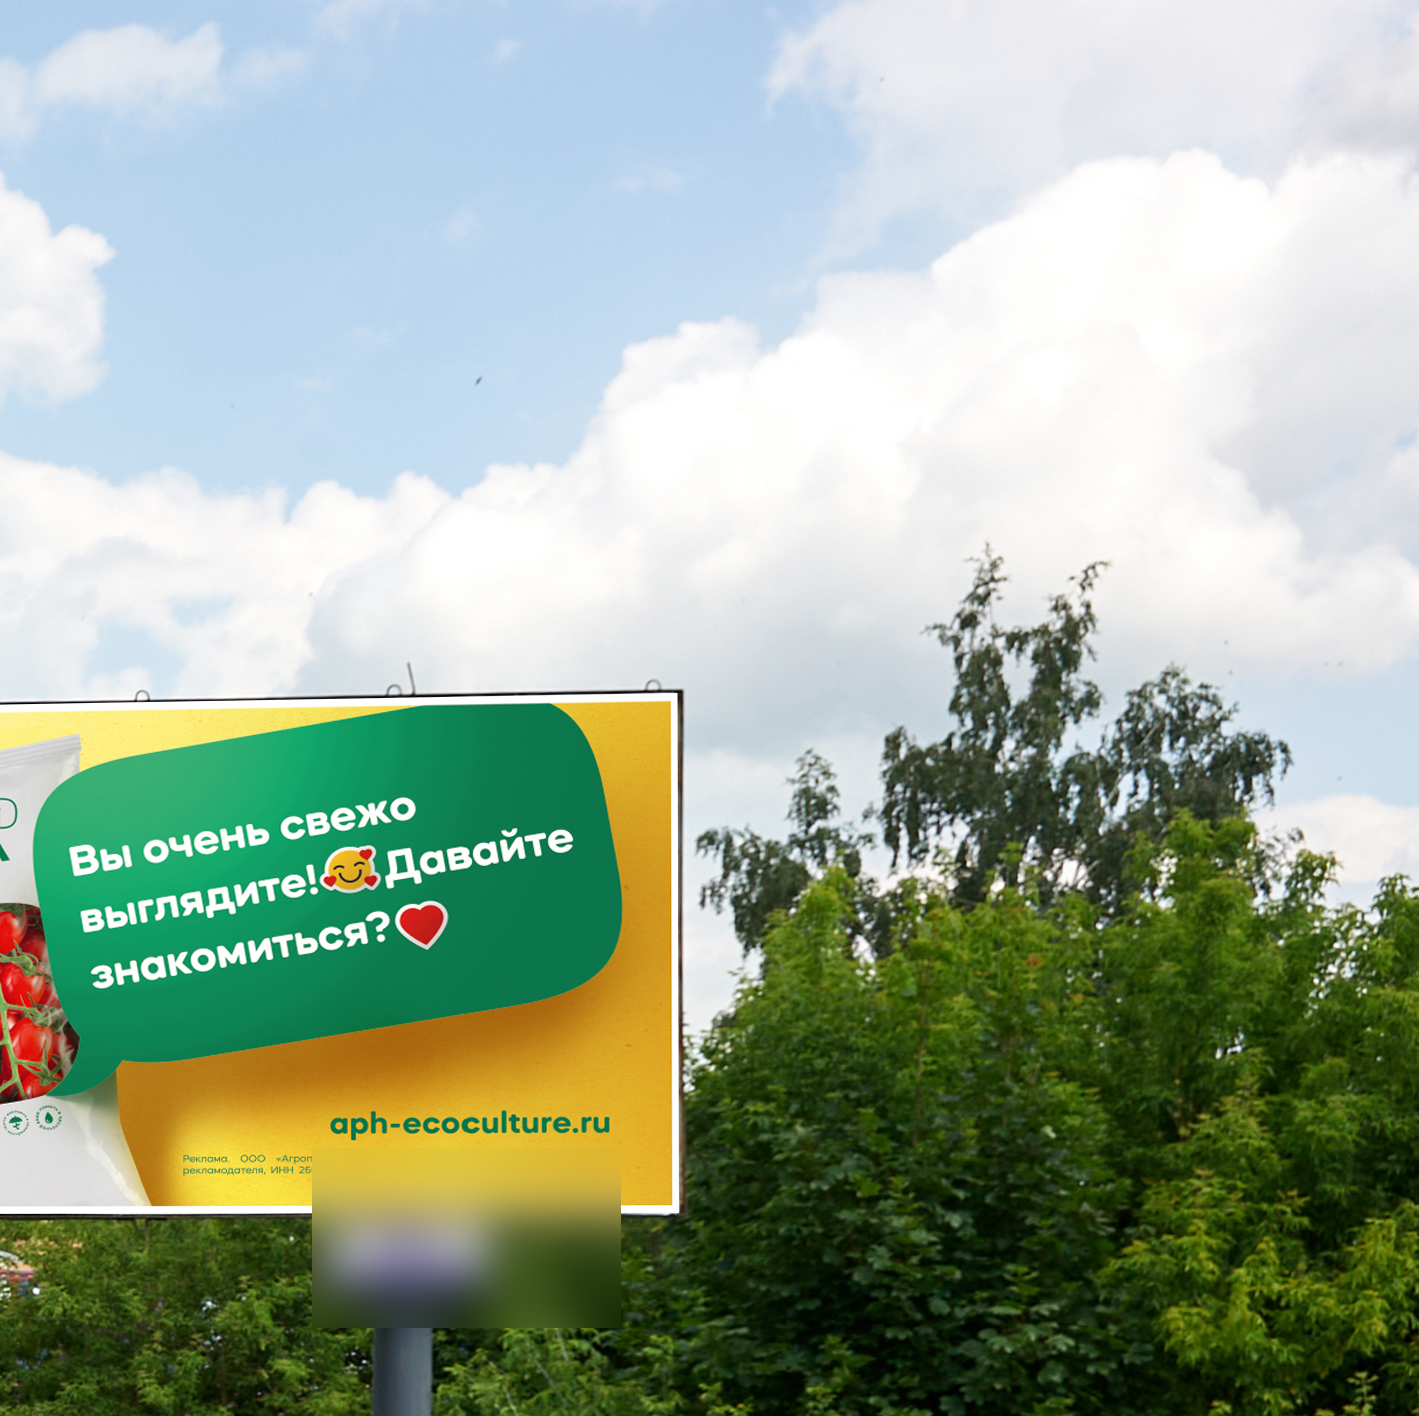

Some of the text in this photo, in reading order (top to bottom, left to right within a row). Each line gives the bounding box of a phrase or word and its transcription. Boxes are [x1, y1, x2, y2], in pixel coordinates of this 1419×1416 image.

[69, 797, 417, 877] Вы очень свежо
[80, 828, 574, 933] выглядите! Давайте
[90, 910, 391, 989] знакомиться?
[330, 1110, 610, 1141] aph-ecoculture.ru
[183, 1154, 230, 1163] Реклама.
[240, 1154, 266, 1163] ООО
[183, 1166, 266, 1176] рекламодателя,
[270, 1166, 294, 1174] ИНН
